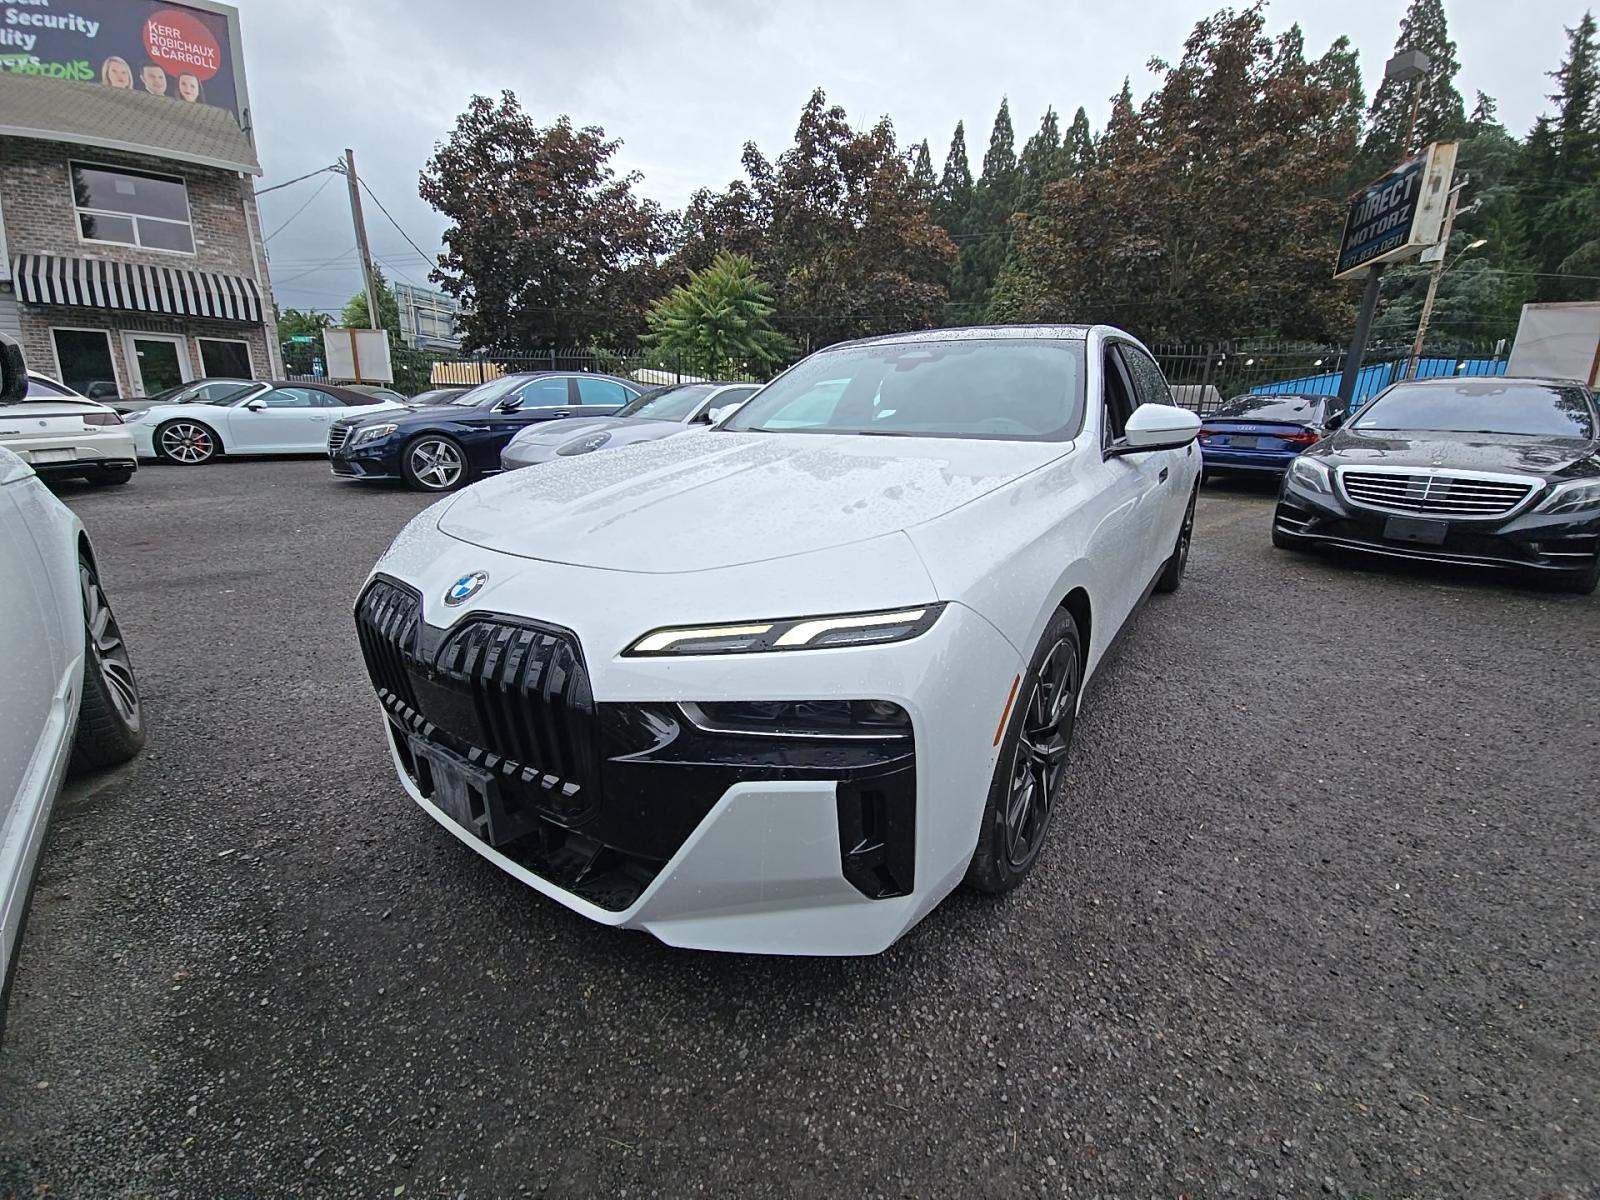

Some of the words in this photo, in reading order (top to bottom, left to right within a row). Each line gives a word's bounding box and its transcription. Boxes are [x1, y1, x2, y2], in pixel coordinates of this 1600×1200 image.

[5, 7, 100, 38] Security
[148, 19, 182, 39] KERR
[149, 32, 215, 58] ROBICHAUX
[1353, 171, 1418, 227] DIRECT
[1347, 204, 1412, 250] MOTORZ
